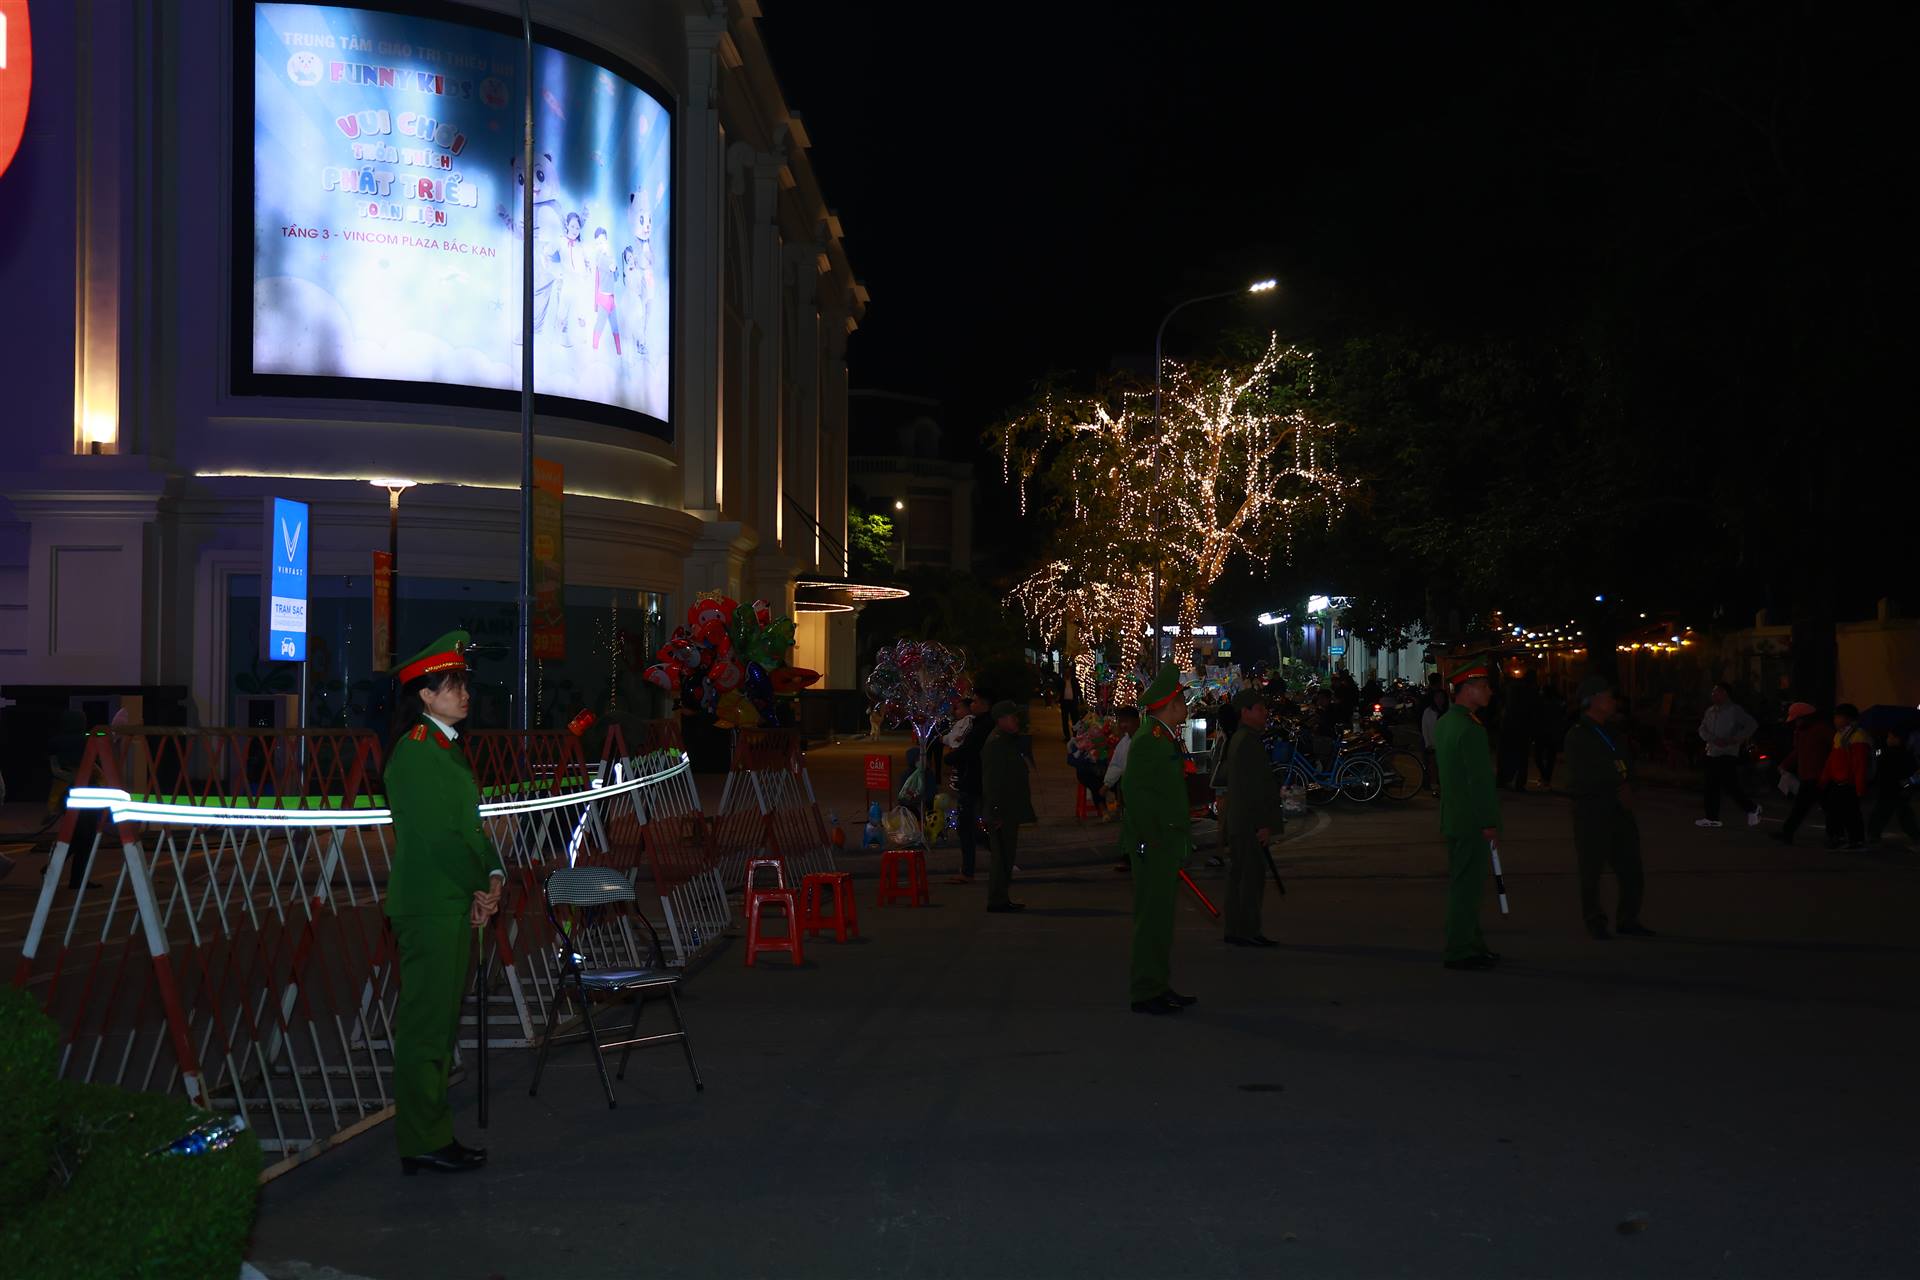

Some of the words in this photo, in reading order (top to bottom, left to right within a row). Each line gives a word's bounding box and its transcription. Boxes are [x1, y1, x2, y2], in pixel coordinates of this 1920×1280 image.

[282, 32, 335, 48] TRUNG
[339, 34, 372, 51] TÂM
[329, 60, 411, 90] FUNNY
[416, 71, 474, 101] KIDS
[336, 110, 391, 139] VUI
[397, 111, 464, 156] CHƠI
[402, 148, 451, 171] THÍCH
[407, 203, 447, 227] IỆN
[282, 223, 318, 239] TẦNG
[322, 228, 329, 240] 3
[343, 230, 397, 245] VINCOM
[402, 235, 439, 250] PLAZA
[278, 566, 303, 576] VINFAST
